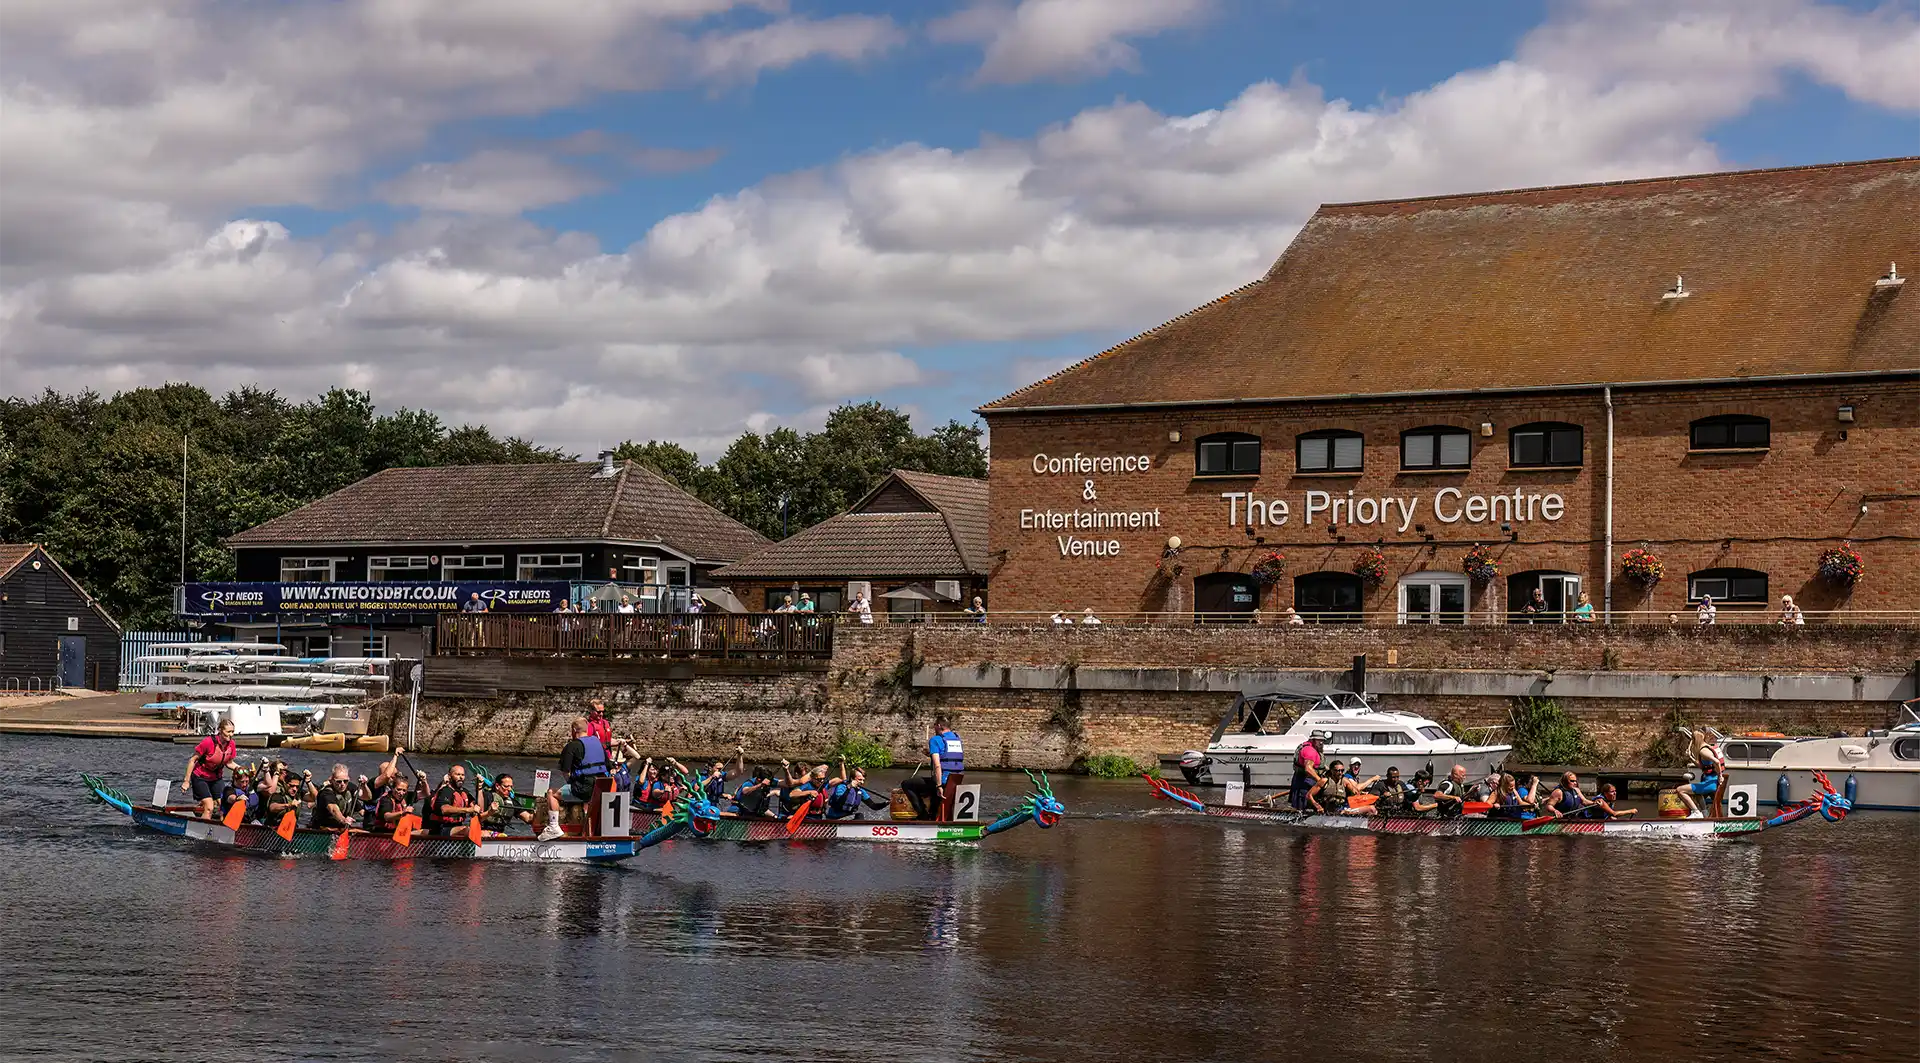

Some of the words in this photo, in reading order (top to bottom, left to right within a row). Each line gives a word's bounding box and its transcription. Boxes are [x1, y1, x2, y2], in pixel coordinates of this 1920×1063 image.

[1032, 453, 1150, 474] Conference
[1083, 479, 1097, 500] &
[1020, 507, 1161, 529] Entertainment
[1222, 491, 1289, 526] The
[1306, 490, 1418, 533] Priory
[1434, 487, 1565, 523] Centre
[1057, 536, 1120, 556] Venue
[225, 592, 235, 601] ST
[236, 591, 263, 601] NEOTS
[280, 586, 459, 600] WWW.STNEOTSDBT.CO.UK
[508, 590, 520, 599] ST
[521, 590, 551, 599] NEOTS
[279, 602, 299, 610] COME
[299, 602, 315, 610] AND
[315, 602, 330, 610] JOIN
[330, 602, 344, 610] THE
[360, 602, 388, 610] BIGGEST
[388, 602, 418, 610] DRAGON
[418, 602, 438, 610] BOAT
[438, 602, 458, 610] TEAM
[608, 795, 622, 828] 1
[956, 791, 975, 820] 2
[1730, 791, 1749, 816] 3
[871, 826, 899, 836] SCCS
